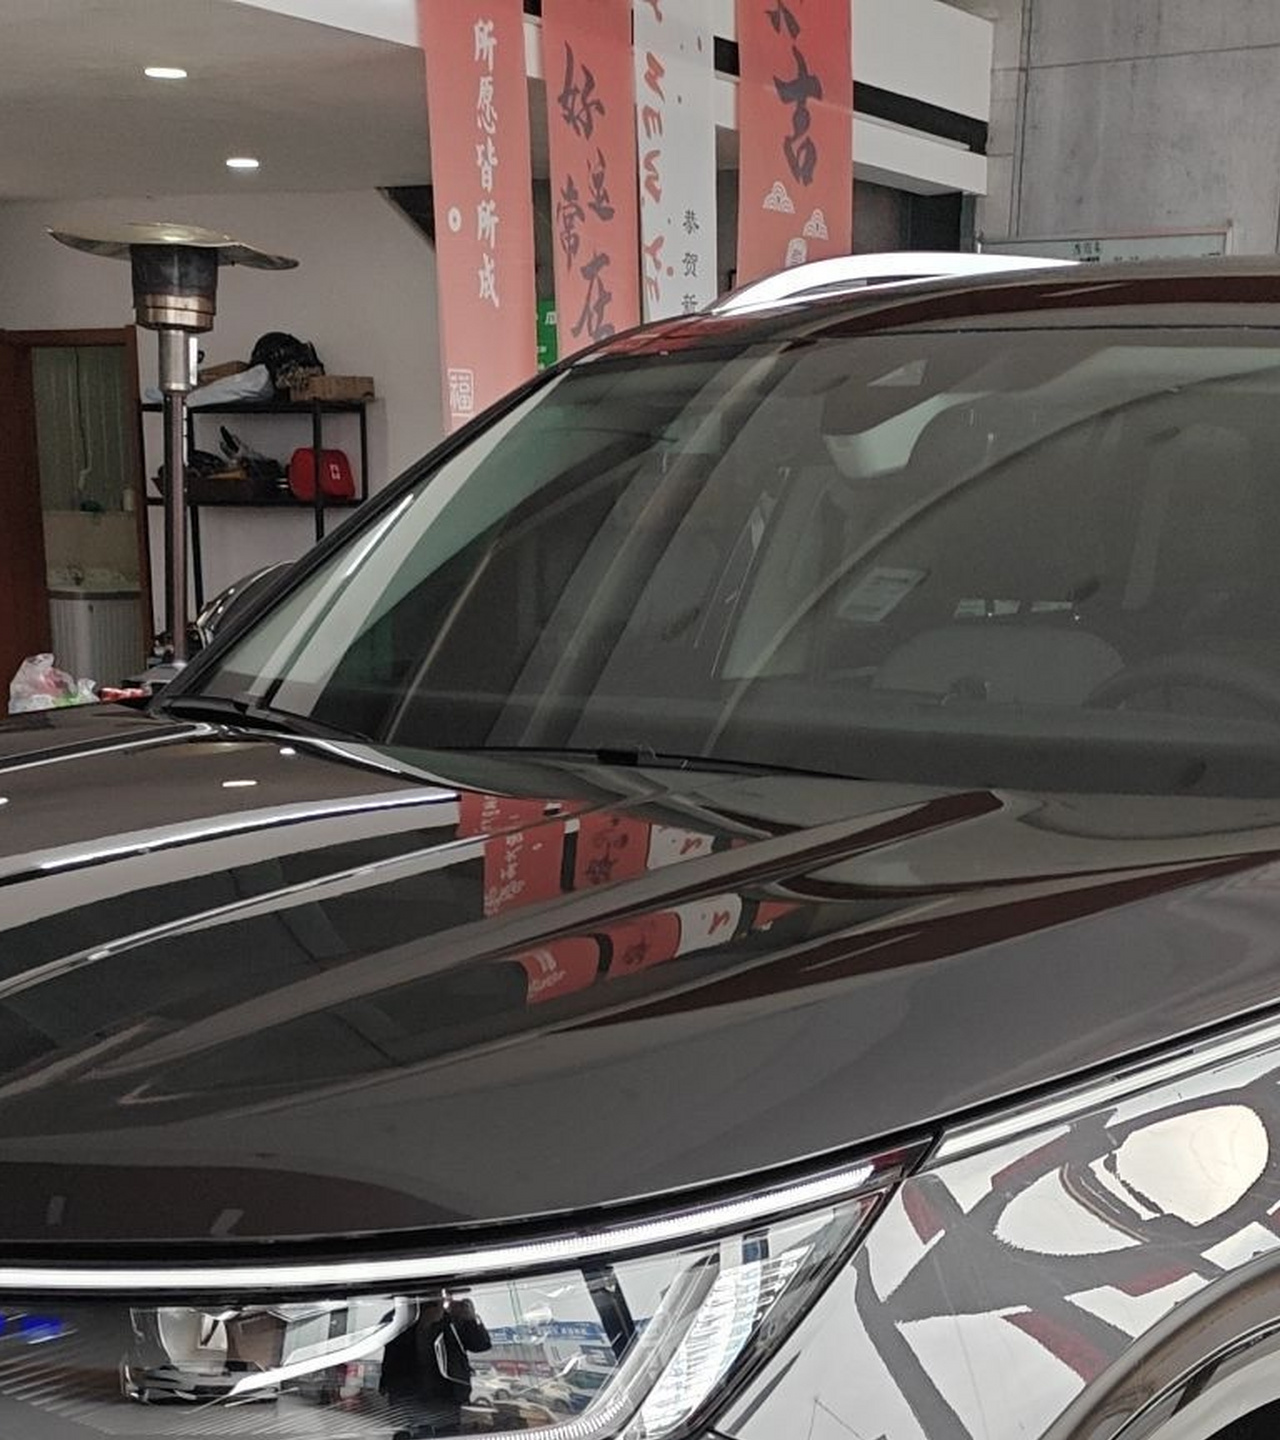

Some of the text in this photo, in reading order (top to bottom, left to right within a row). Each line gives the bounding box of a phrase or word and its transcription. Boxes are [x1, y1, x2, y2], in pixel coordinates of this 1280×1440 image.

[472, 18, 501, 309] 所愿皆所成
[642, 51, 666, 204] NEW
[448, 369, 474, 414] 福
